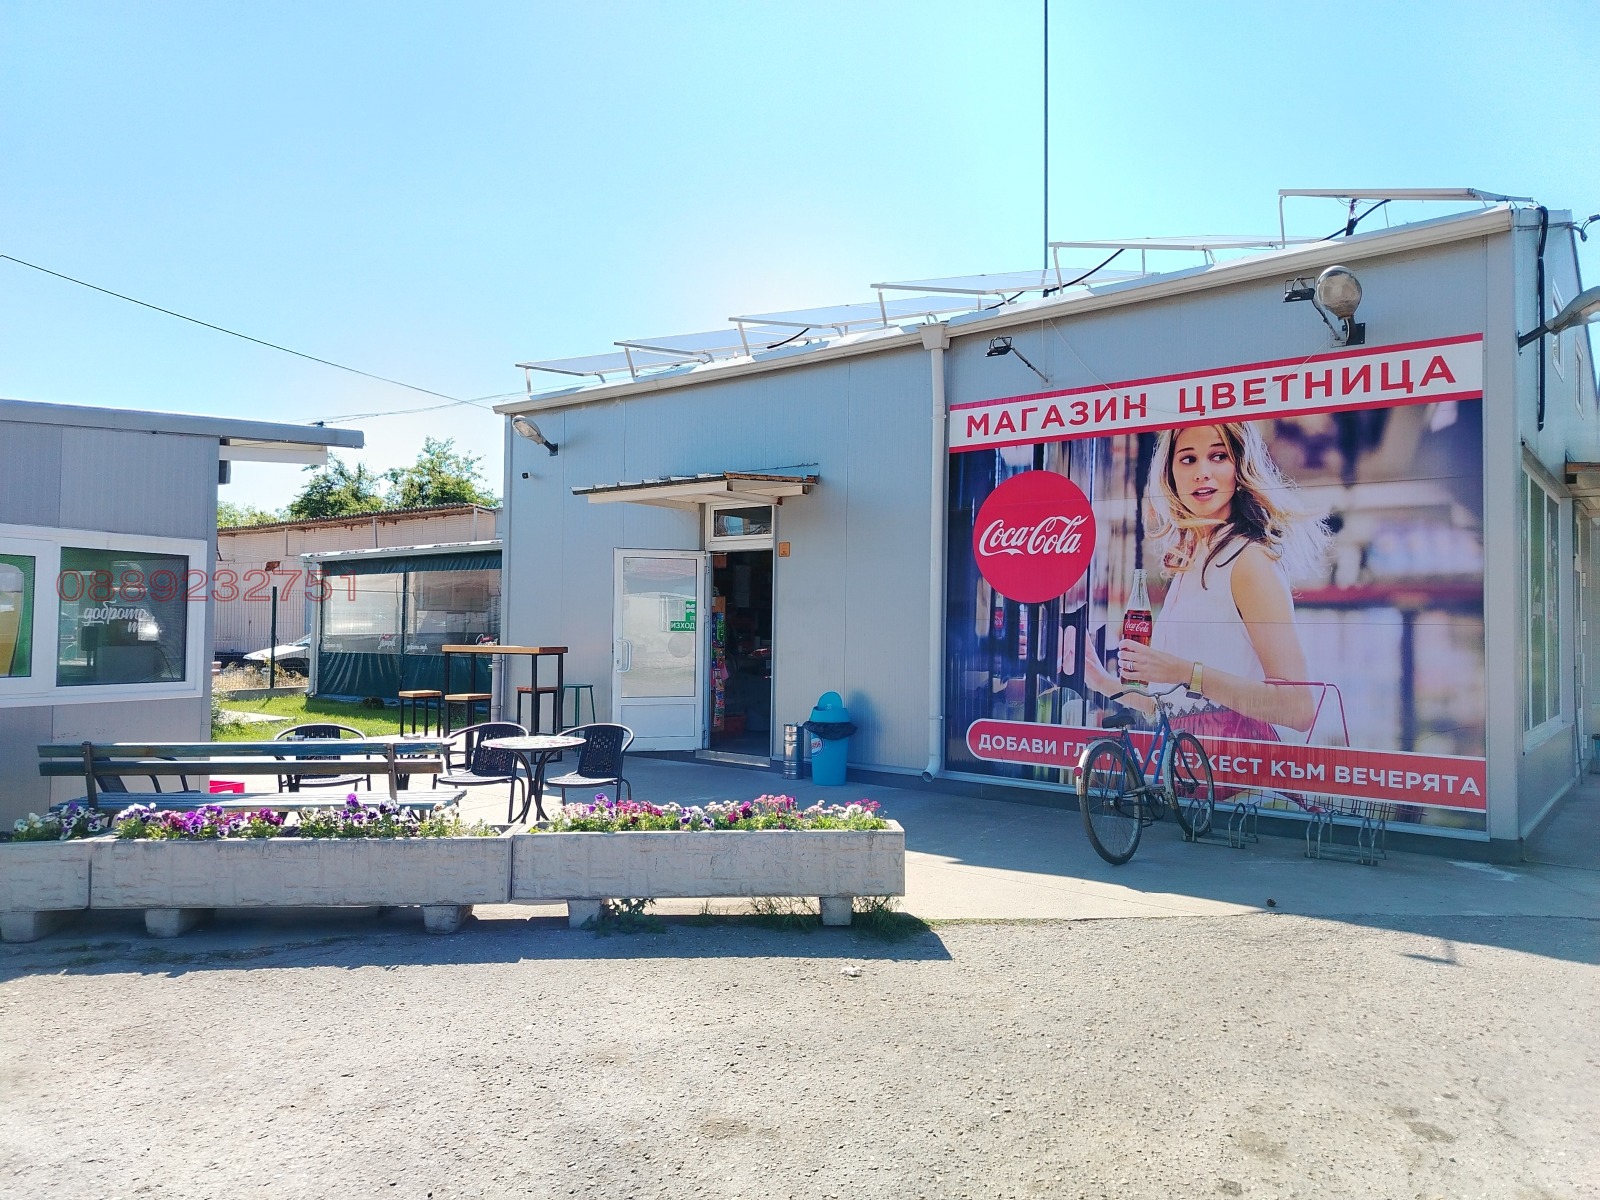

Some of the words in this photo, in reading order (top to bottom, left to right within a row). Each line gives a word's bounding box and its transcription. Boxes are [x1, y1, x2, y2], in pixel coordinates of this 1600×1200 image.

[966, 393, 1147, 438] МАГАЗИН
[1179, 355, 1456, 416] ЦВЕТНИЦА
[979, 515, 1089, 556] Coca-Cola
[671, 622, 695, 630] ИЗХОД
[1125, 620, 1150, 632] Coca-Cola
[978, 734, 1057, 755] ДОБАВИ
[1271, 760, 1325, 781] КЪМ
[1334, 765, 1480, 796] ВЕЧЕРЯТА
